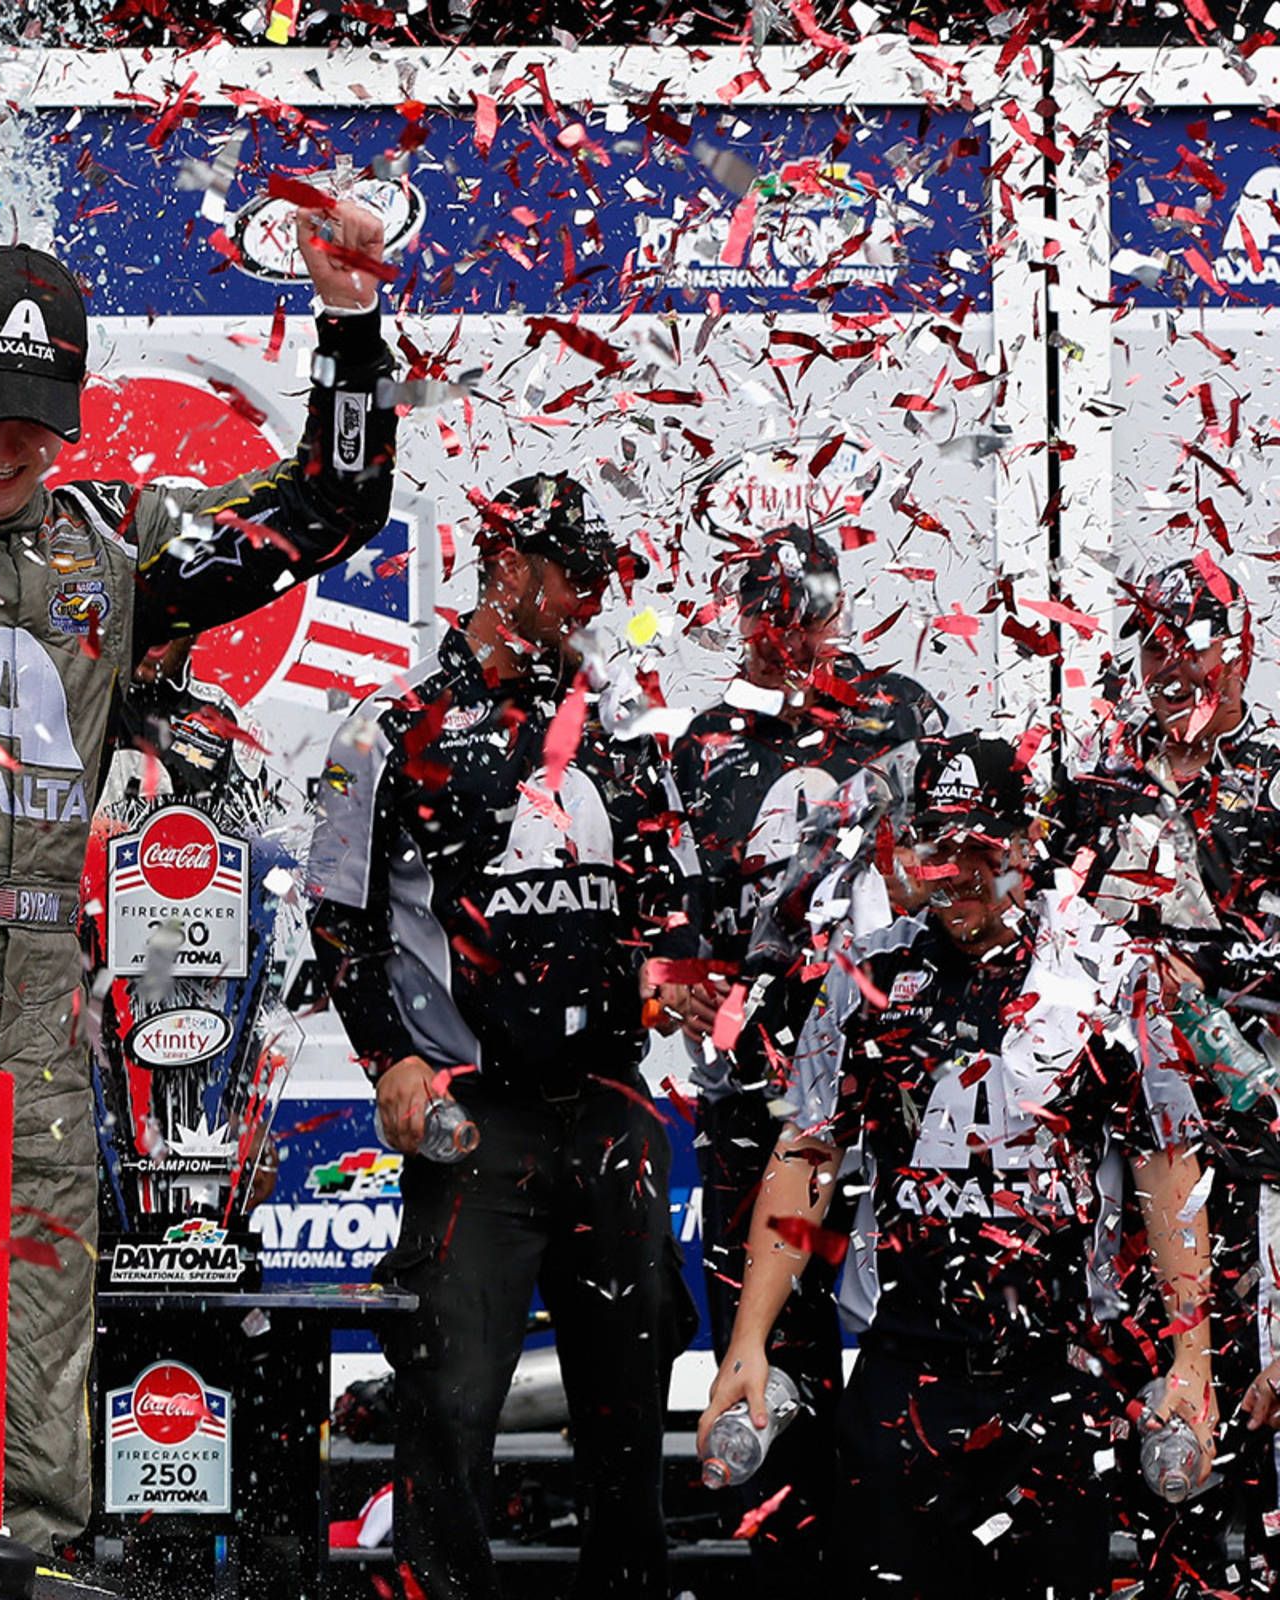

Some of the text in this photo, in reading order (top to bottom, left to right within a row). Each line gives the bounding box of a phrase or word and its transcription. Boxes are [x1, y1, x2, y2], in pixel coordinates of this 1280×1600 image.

[932, 785, 980, 801] AXALT
[143, 842, 215, 870] Coca-Cola
[19, 891, 61, 922] BYRON
[121, 905, 236, 919] FIRECRACKER
[131, 954, 148, 965] AT
[142, 1029, 210, 1053] xfinity
[138, 1160, 211, 1172] CHAMPION
[249, 1203, 404, 1250] AYTON
[115, 1247, 237, 1270] DAYTONA
[257, 1251, 347, 1268] NATIONAL
[113, 1271, 238, 1280] INTERNATIONAL SPEEDWAY
[117, 1450, 220, 1460] FIRECRACKER
[140, 1463, 197, 1487] 250
[126, 1489, 208, 1502] AT DAYTONA
